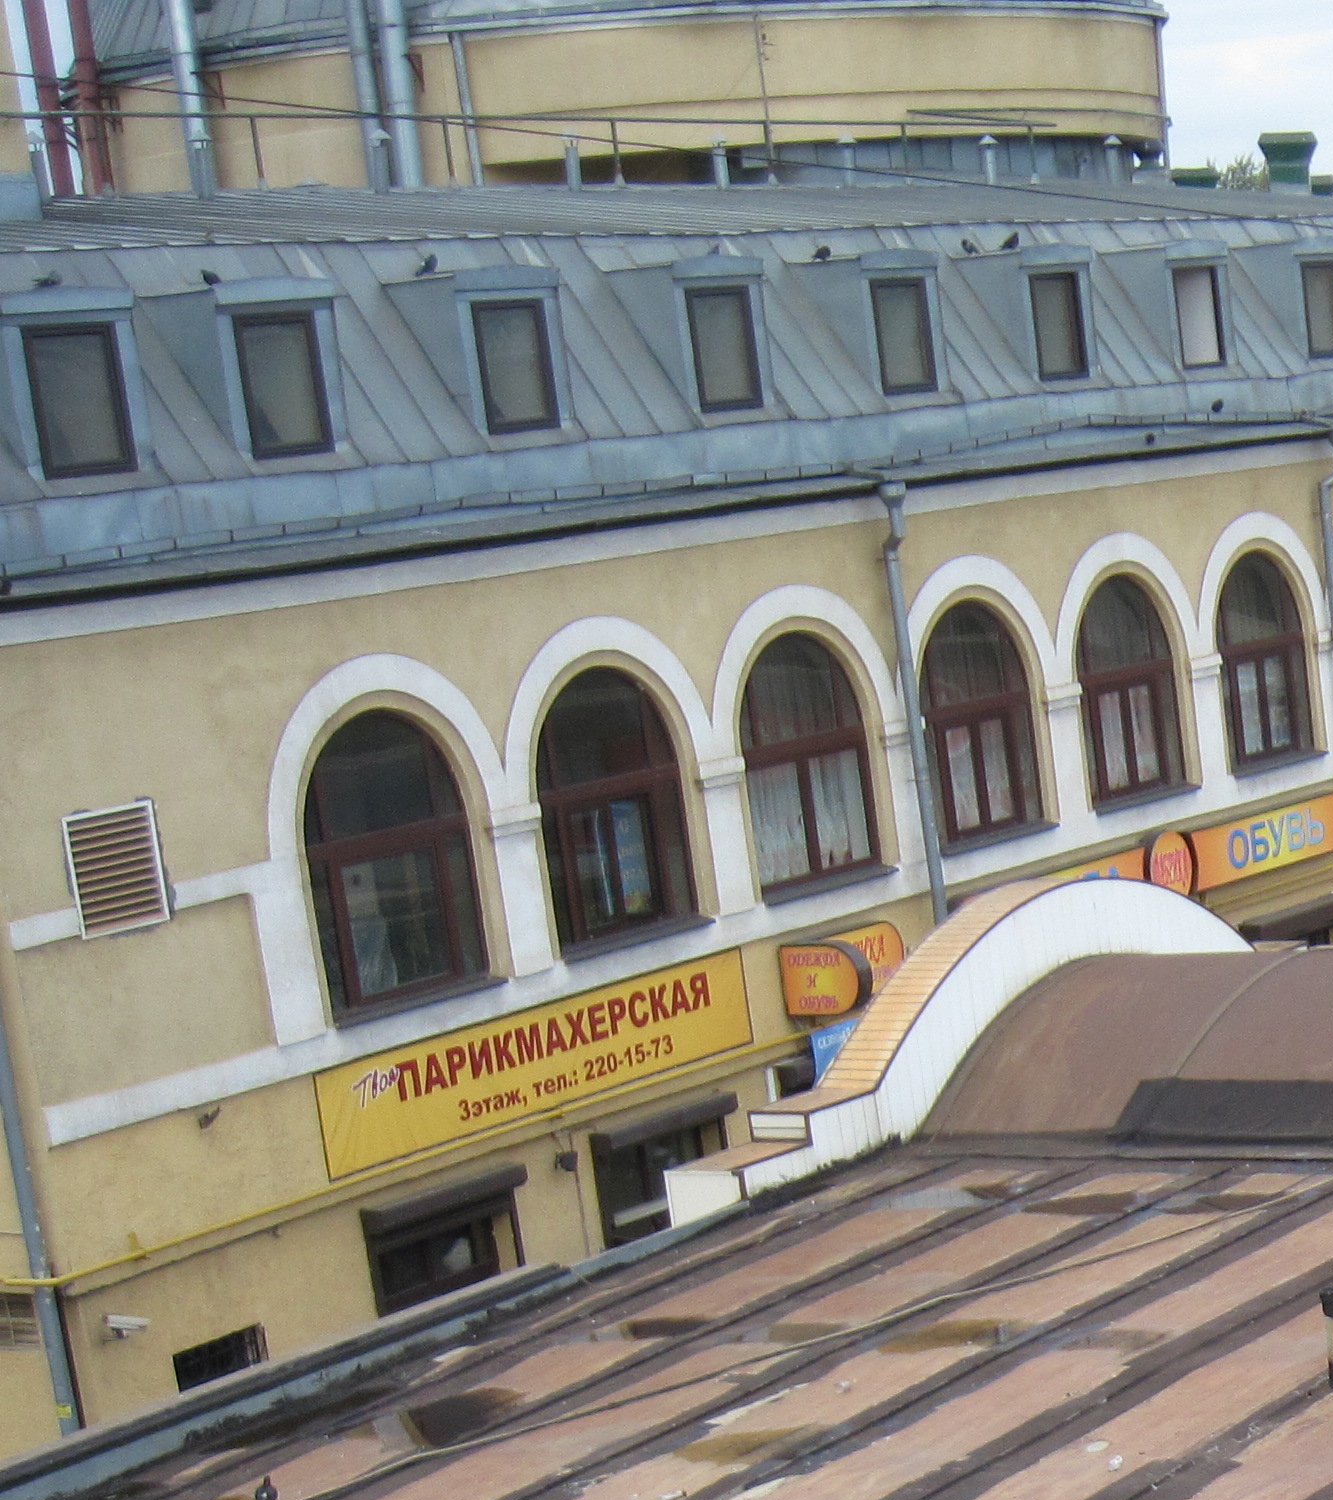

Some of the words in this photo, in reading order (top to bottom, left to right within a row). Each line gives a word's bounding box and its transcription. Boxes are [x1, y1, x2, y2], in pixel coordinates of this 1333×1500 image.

[1227, 807, 1325, 869] ОБУВЬ
[788, 952, 841, 968] ОДЕЖДА
[799, 995, 839, 1011] ОБУВЬ
[396, 971, 713, 1102] ПАРИКМАХЕРСКАЯ
[532, 1067, 579, 1099] тел.:
[584, 1034, 674, 1082] 220-15-73
